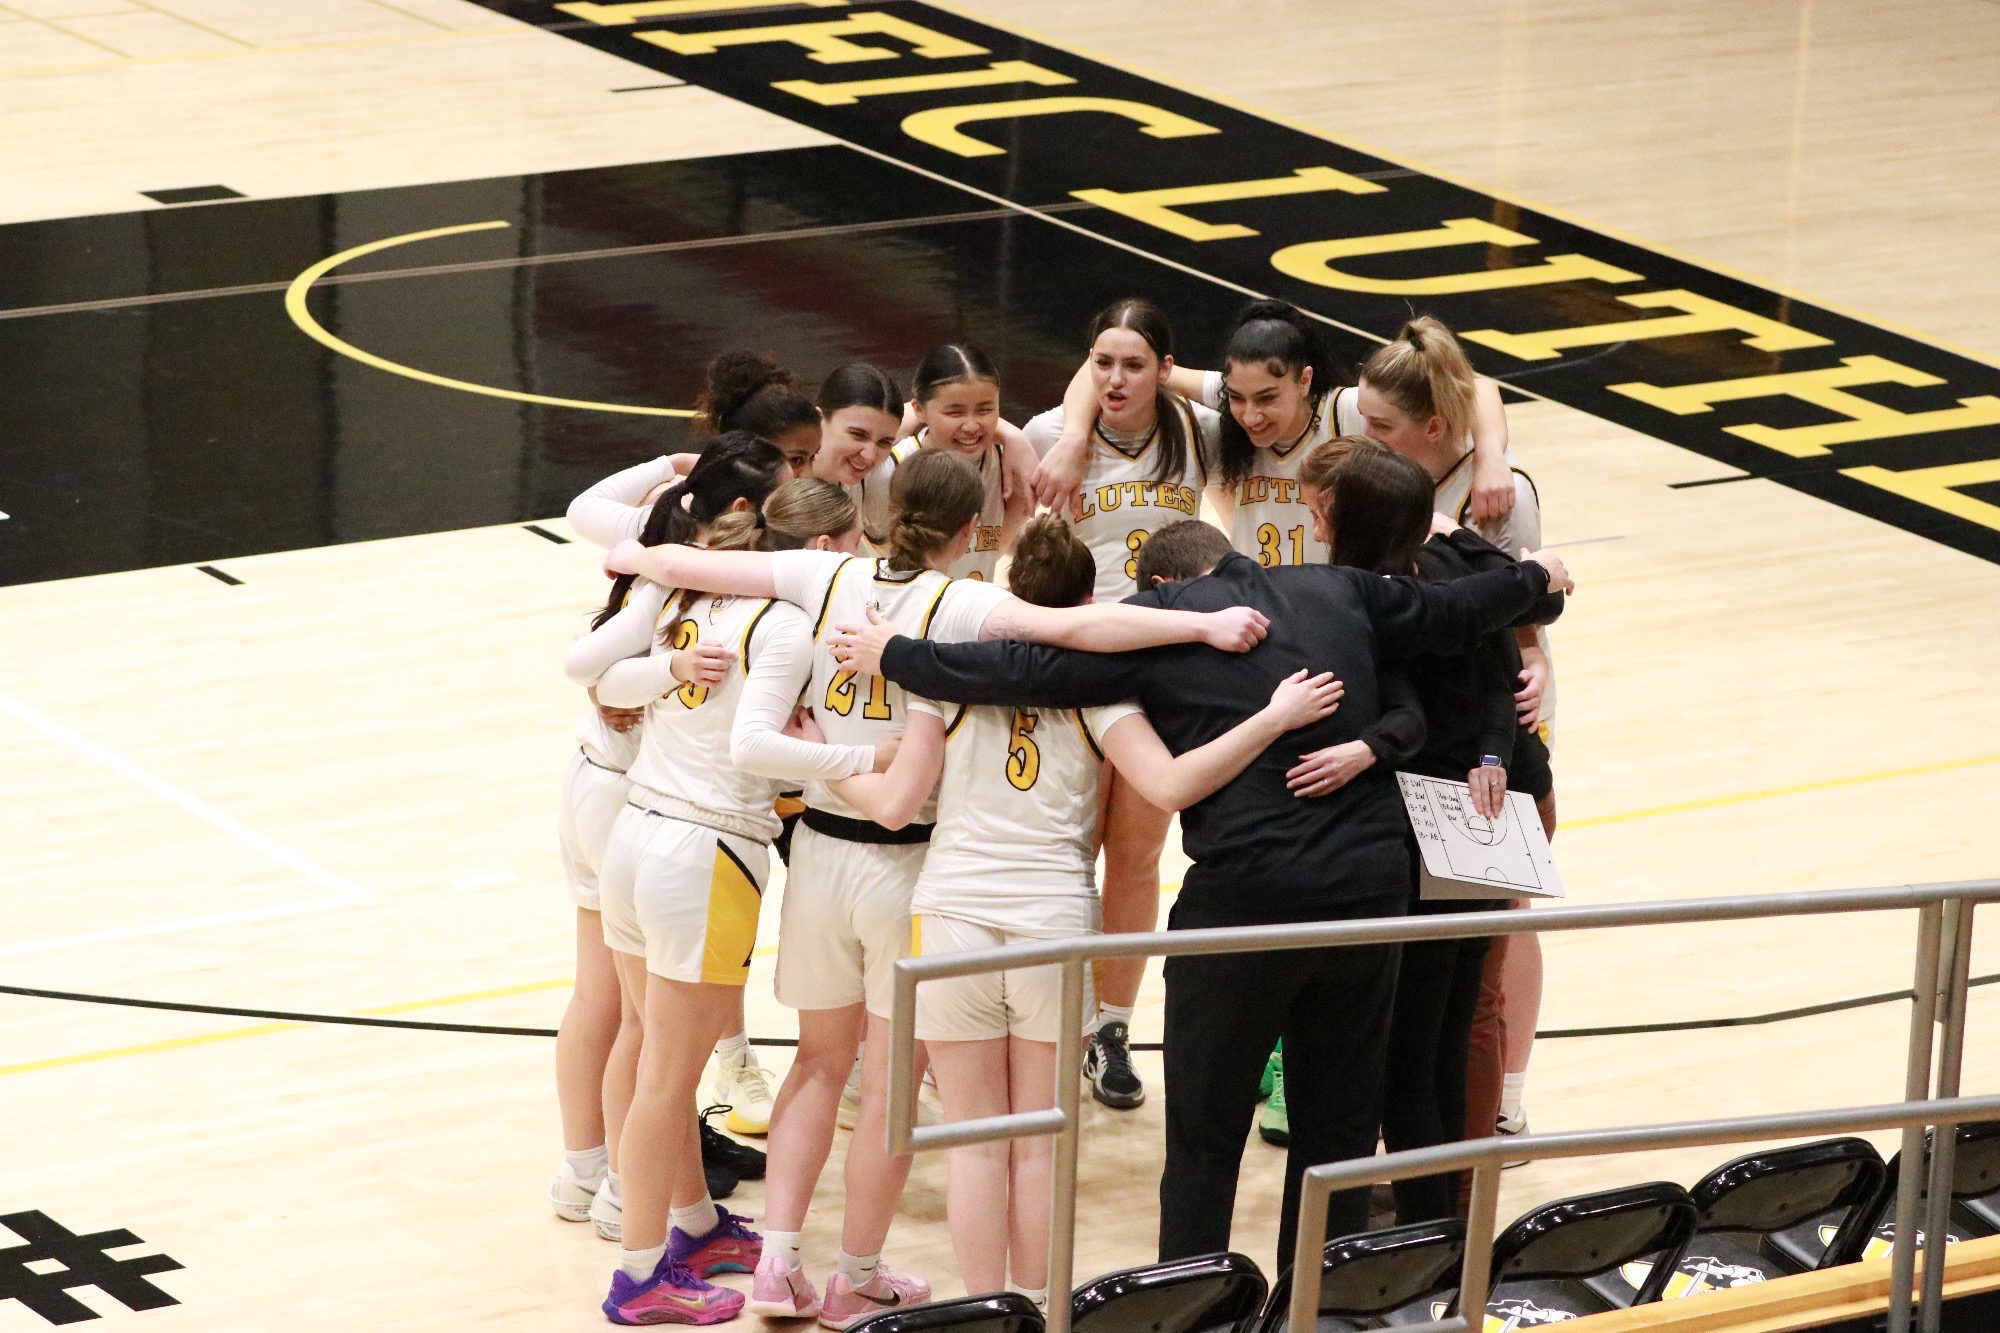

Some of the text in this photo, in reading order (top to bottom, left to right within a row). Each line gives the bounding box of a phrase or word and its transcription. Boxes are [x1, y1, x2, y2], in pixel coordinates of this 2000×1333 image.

[1074, 480, 1196, 524] LUTES
[1257, 522, 1304, 568] 31
[1006, 706, 1040, 791] 5
